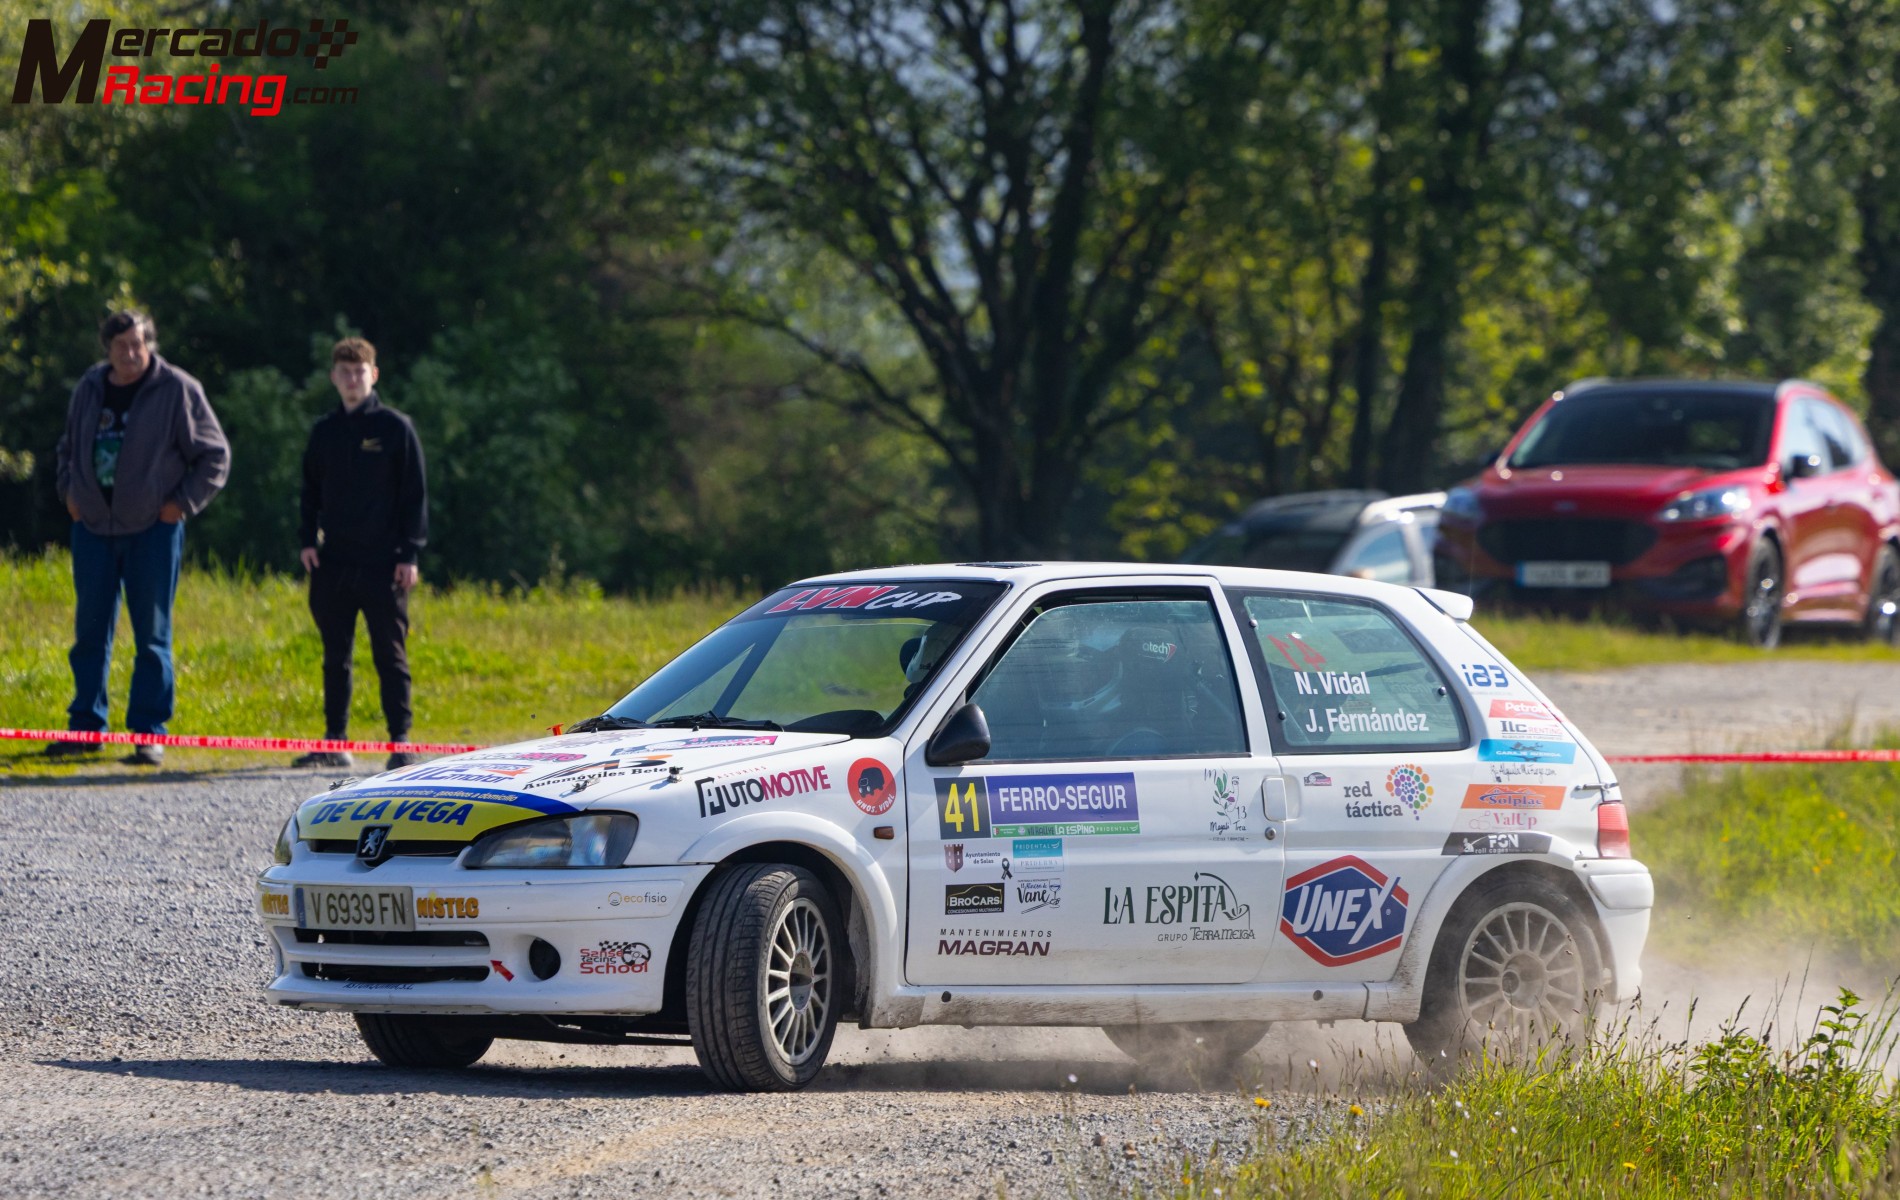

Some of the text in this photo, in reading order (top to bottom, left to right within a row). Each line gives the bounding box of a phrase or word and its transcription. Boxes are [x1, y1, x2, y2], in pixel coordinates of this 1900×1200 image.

[864, 590, 963, 611] CUP
[1294, 672, 1319, 695] N.
[1317, 671, 1371, 695] Vidal
[1306, 706, 1430, 733] J. Fernández
[522, 770, 626, 790] Automóviles
[1343, 781, 1373, 798] red
[310, 799, 475, 826] DE LA VEGA
[878, 794, 896, 812] VIDAL
[944, 782, 1128, 833] 41 FERRO-SEGUR
[1345, 800, 1404, 818] táctica
[965, 851, 1001, 859] Ayuntamiento
[623, 892, 667, 903] ecofisio
[1103, 884, 1227, 925] LA ESPITA
[311, 892, 406, 925] V 6939 FN
[416, 896, 480, 919] NISTEC
[1291, 876, 1401, 944] UNEX
[939, 928, 1052, 938] MANTENIMIENTOS
[1157, 933, 1188, 942] GRUPO
[580, 948, 624, 958] Sanse
[938, 939, 1051, 956] MAGRAN
[580, 960, 648, 975] School
